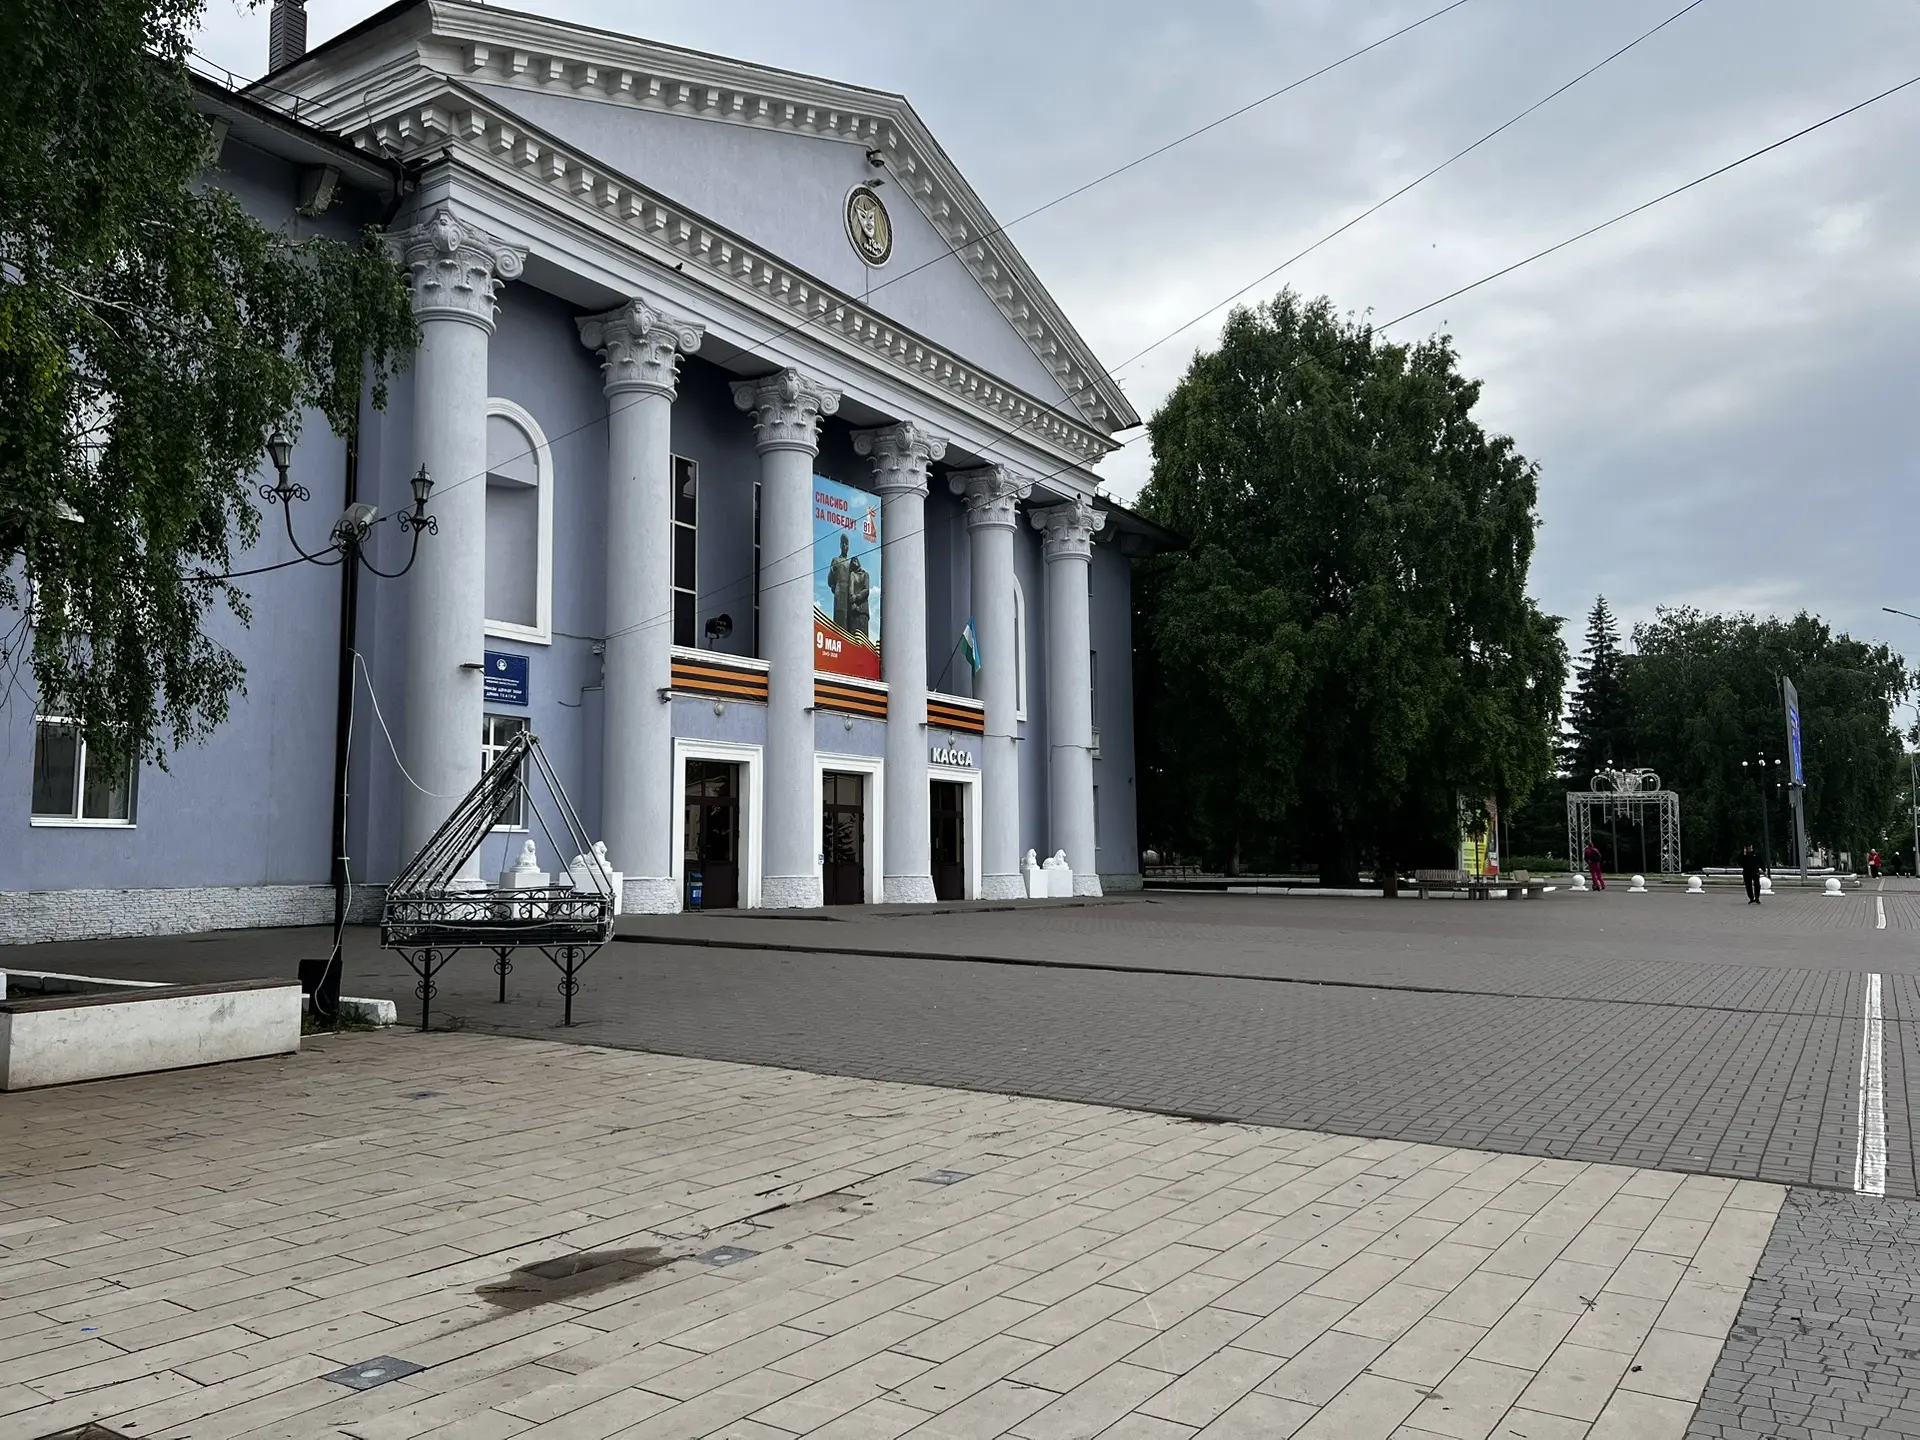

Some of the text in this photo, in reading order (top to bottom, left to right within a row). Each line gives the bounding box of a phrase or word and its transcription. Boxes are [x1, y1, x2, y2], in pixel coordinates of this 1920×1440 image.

[815, 491, 848, 512] СПАСИБО
[815, 507, 857, 530] ЗА ПОБЕДУ!
[816, 631, 842, 653] 9 МАЯ
[932, 747, 973, 766] КАССА
